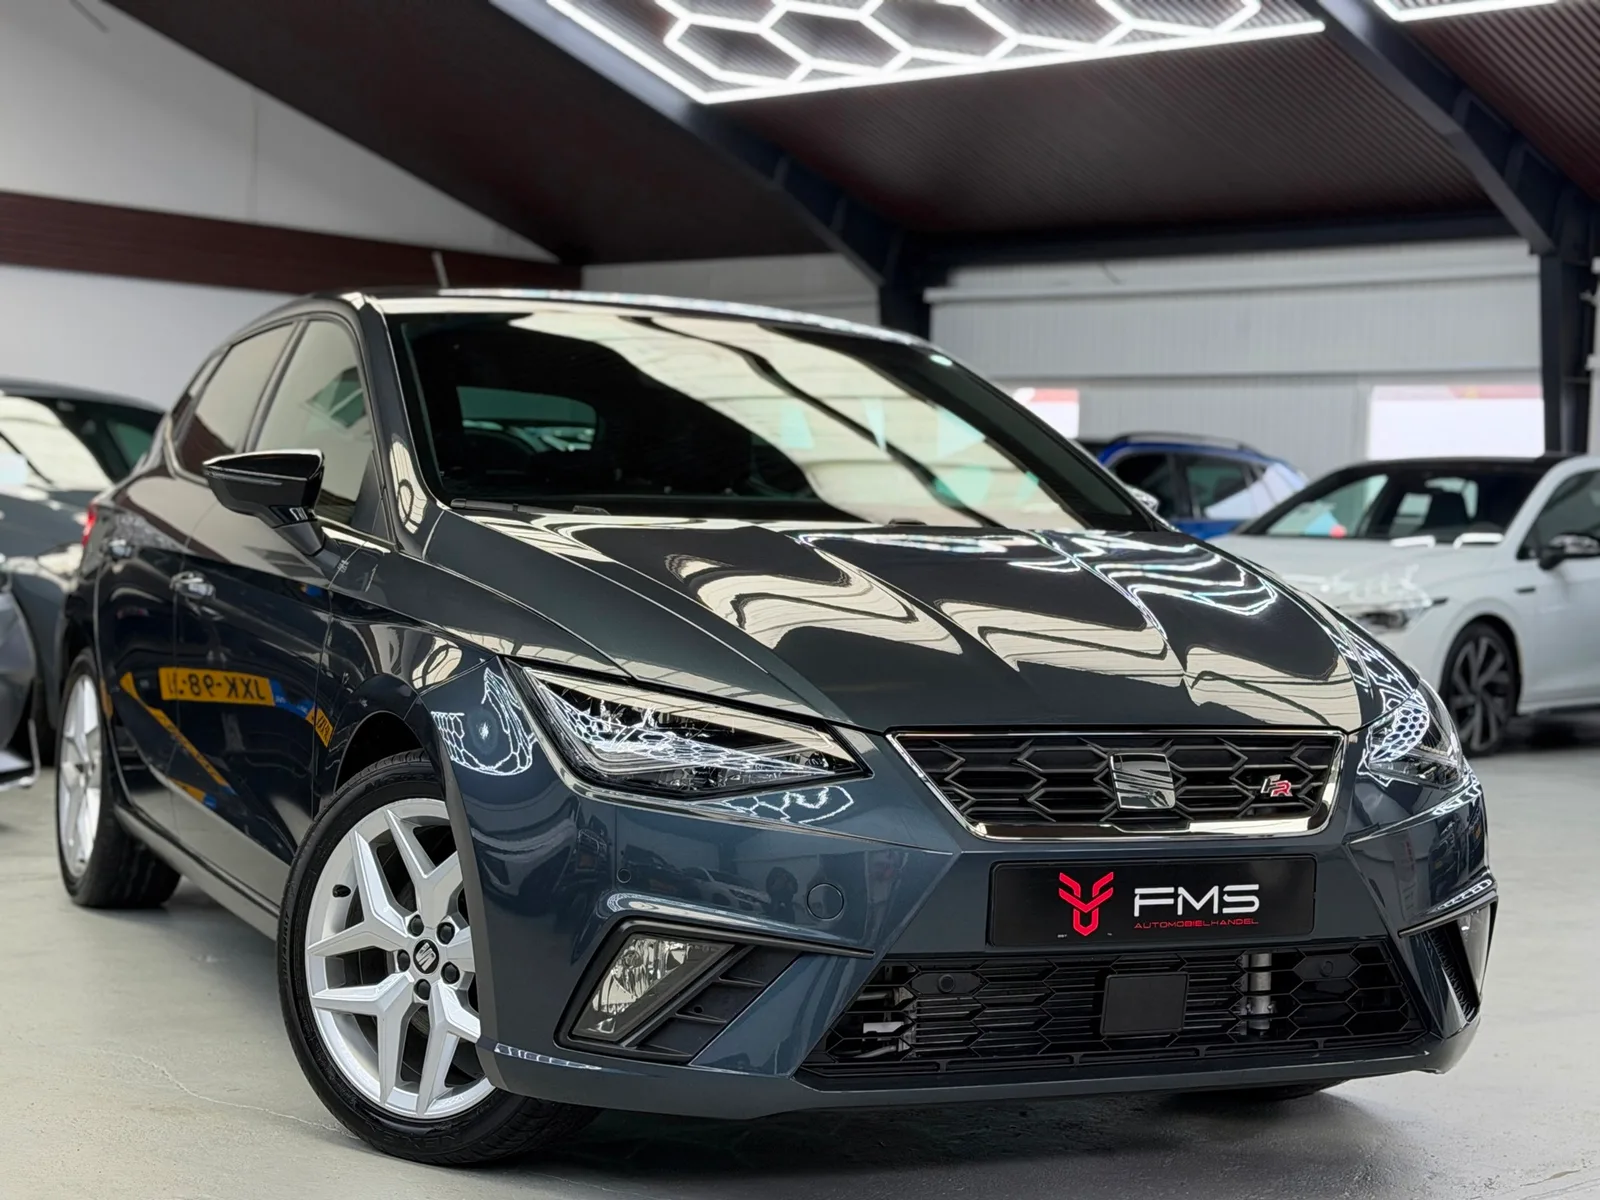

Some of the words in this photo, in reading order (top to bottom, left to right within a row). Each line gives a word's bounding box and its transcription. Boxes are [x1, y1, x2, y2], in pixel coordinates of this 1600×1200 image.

[1260, 774, 1293, 797] FR
[1133, 884, 1260, 917] FMS
[1133, 918, 1260, 929] AUTOMOBIELHANDEL
